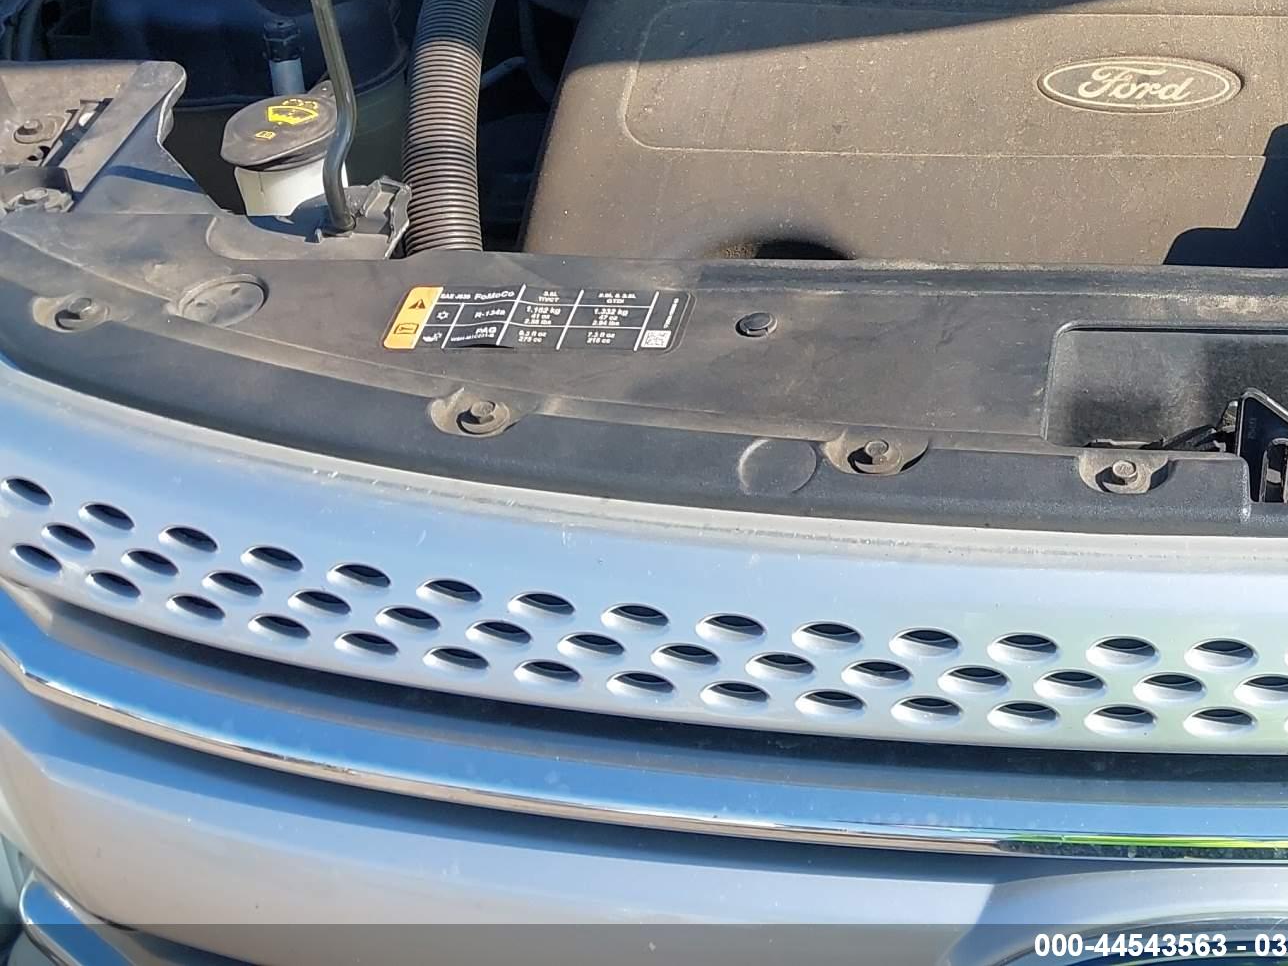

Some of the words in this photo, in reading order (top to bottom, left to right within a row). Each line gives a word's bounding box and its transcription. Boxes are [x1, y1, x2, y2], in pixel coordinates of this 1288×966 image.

[1078, 66, 1194, 100] Ford
[474, 290, 515, 300] FoMoCo
[549, 307, 561, 316] kg
[617, 309, 629, 317] kg
